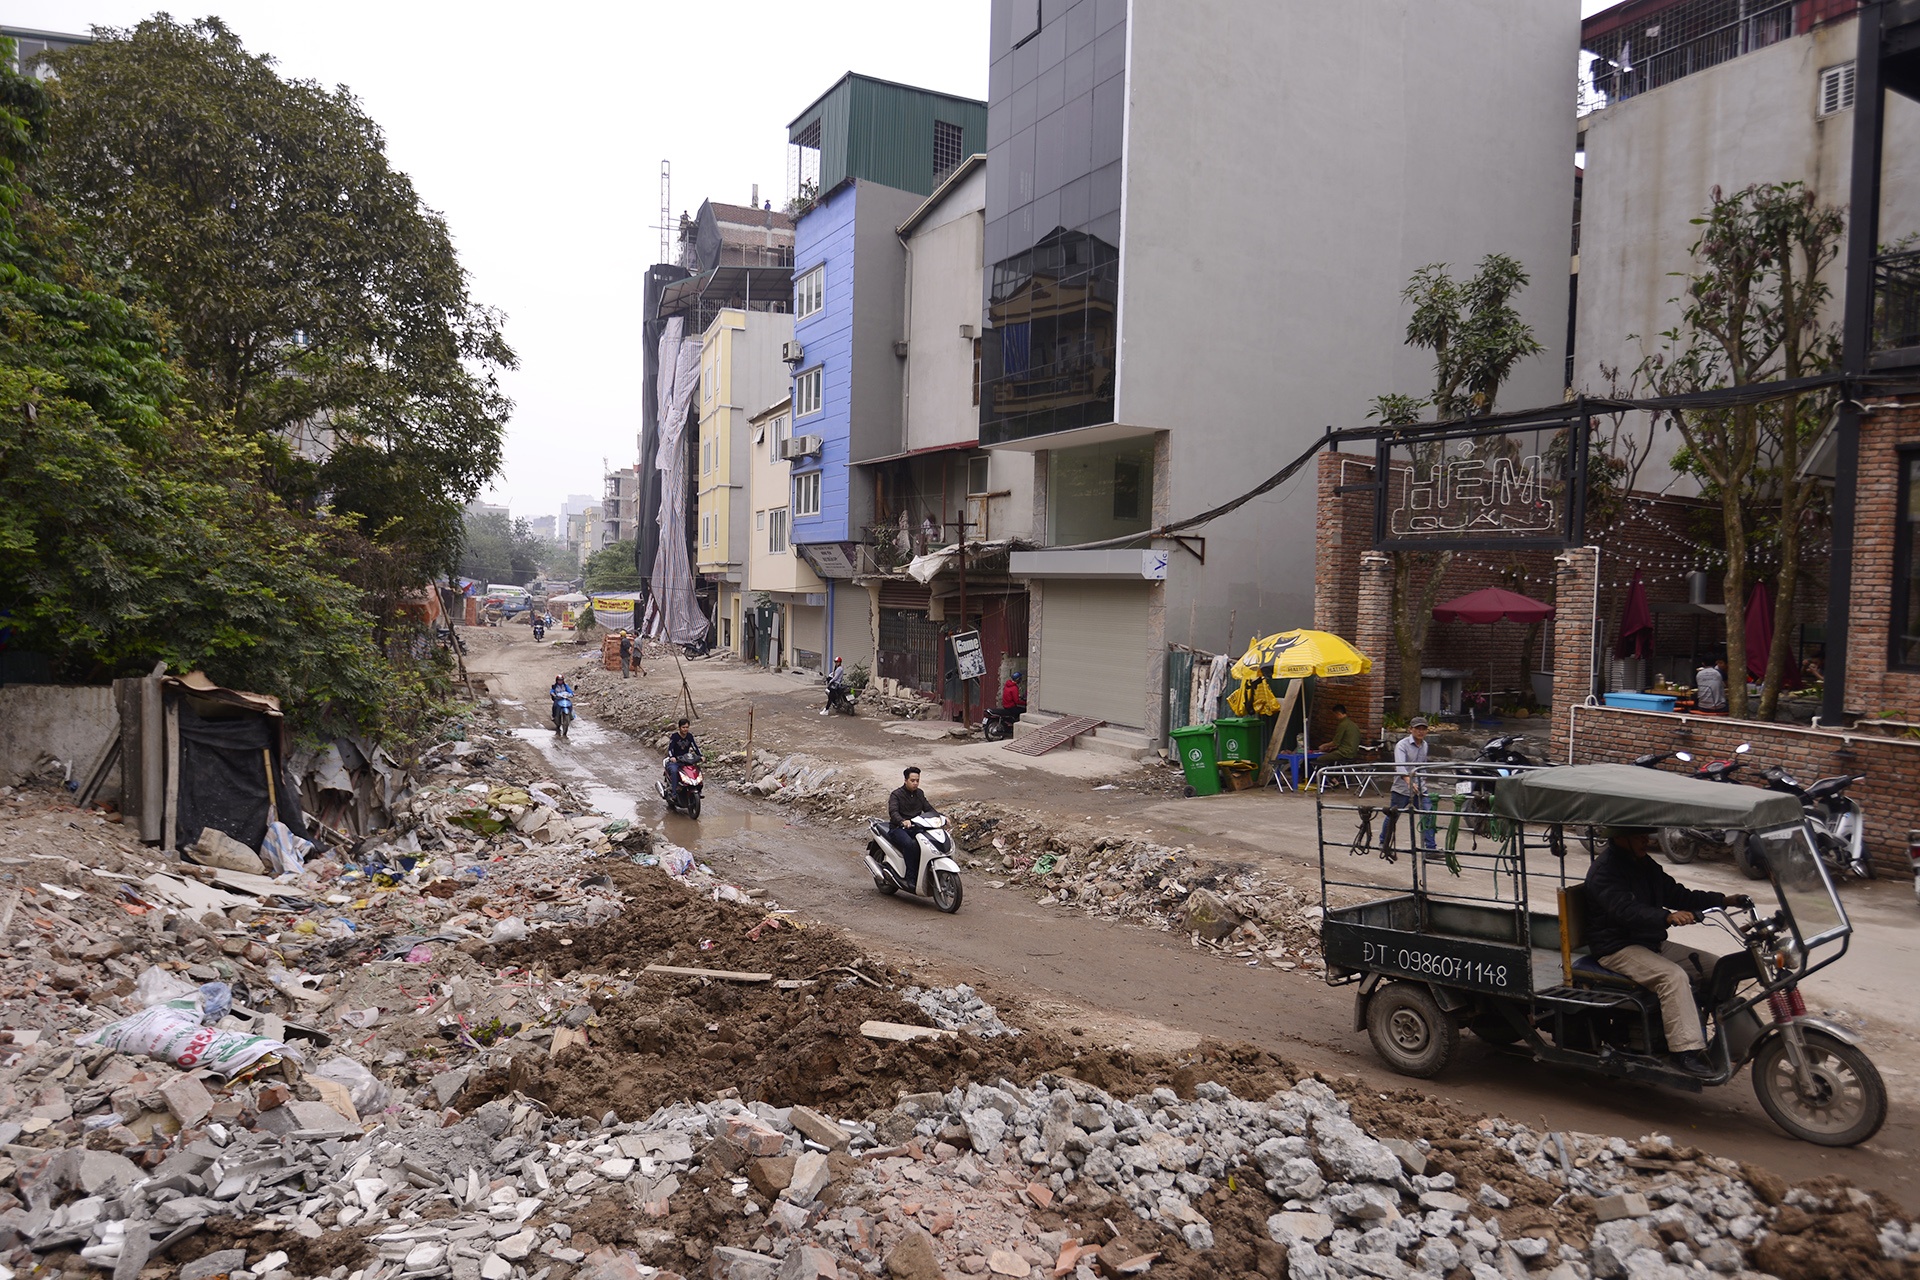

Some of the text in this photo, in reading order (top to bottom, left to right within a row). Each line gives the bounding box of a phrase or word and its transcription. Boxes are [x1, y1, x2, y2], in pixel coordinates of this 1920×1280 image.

[1404, 441, 1542, 509] HẺM
[1410, 509, 1533, 529] QUÁN
[956, 638, 979, 653] Game
[1398, 949, 1507, 986] 0986071148
